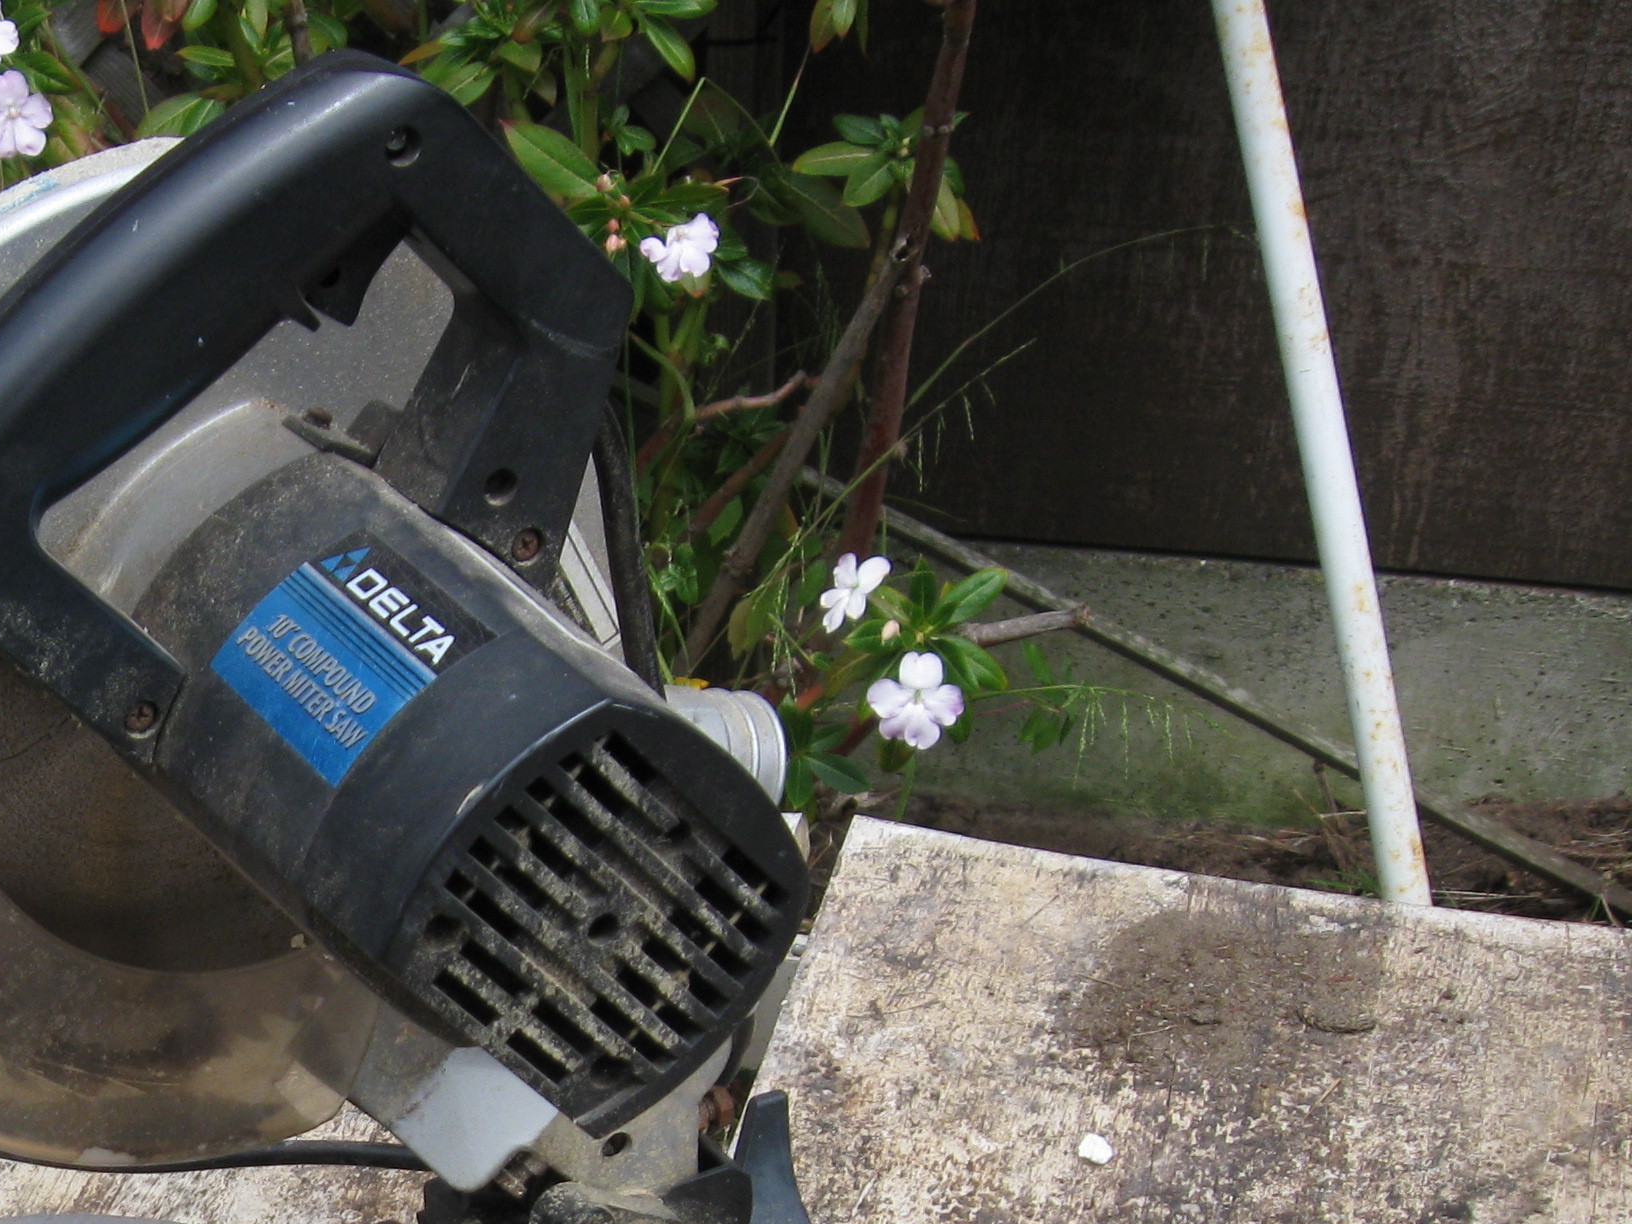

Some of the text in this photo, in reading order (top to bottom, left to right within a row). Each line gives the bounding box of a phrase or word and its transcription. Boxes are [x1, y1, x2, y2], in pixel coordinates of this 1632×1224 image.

[265, 611, 379, 717] 10" COMPOUND
[344, 566, 458, 667] DELTA
[234, 625, 368, 751] POWER MITER SAW
